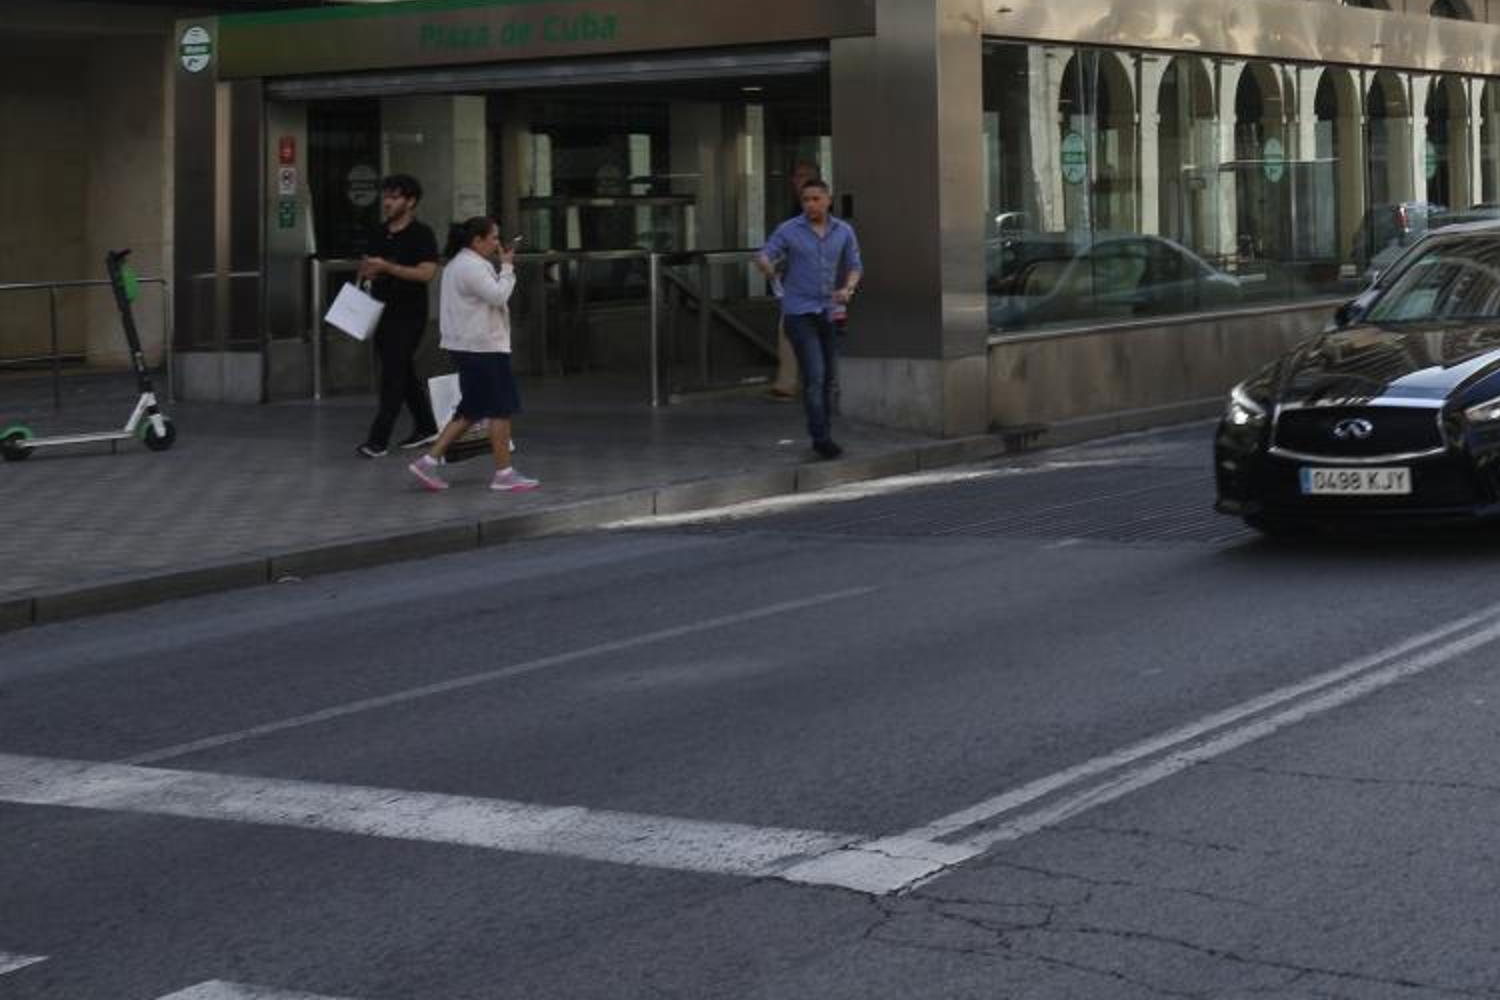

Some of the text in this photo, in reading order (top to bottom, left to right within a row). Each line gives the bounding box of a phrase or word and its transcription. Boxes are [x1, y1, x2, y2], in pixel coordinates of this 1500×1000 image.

[420, 10, 619, 48] Plaza de Cuba
[1365, 471, 1406, 490] KJY
